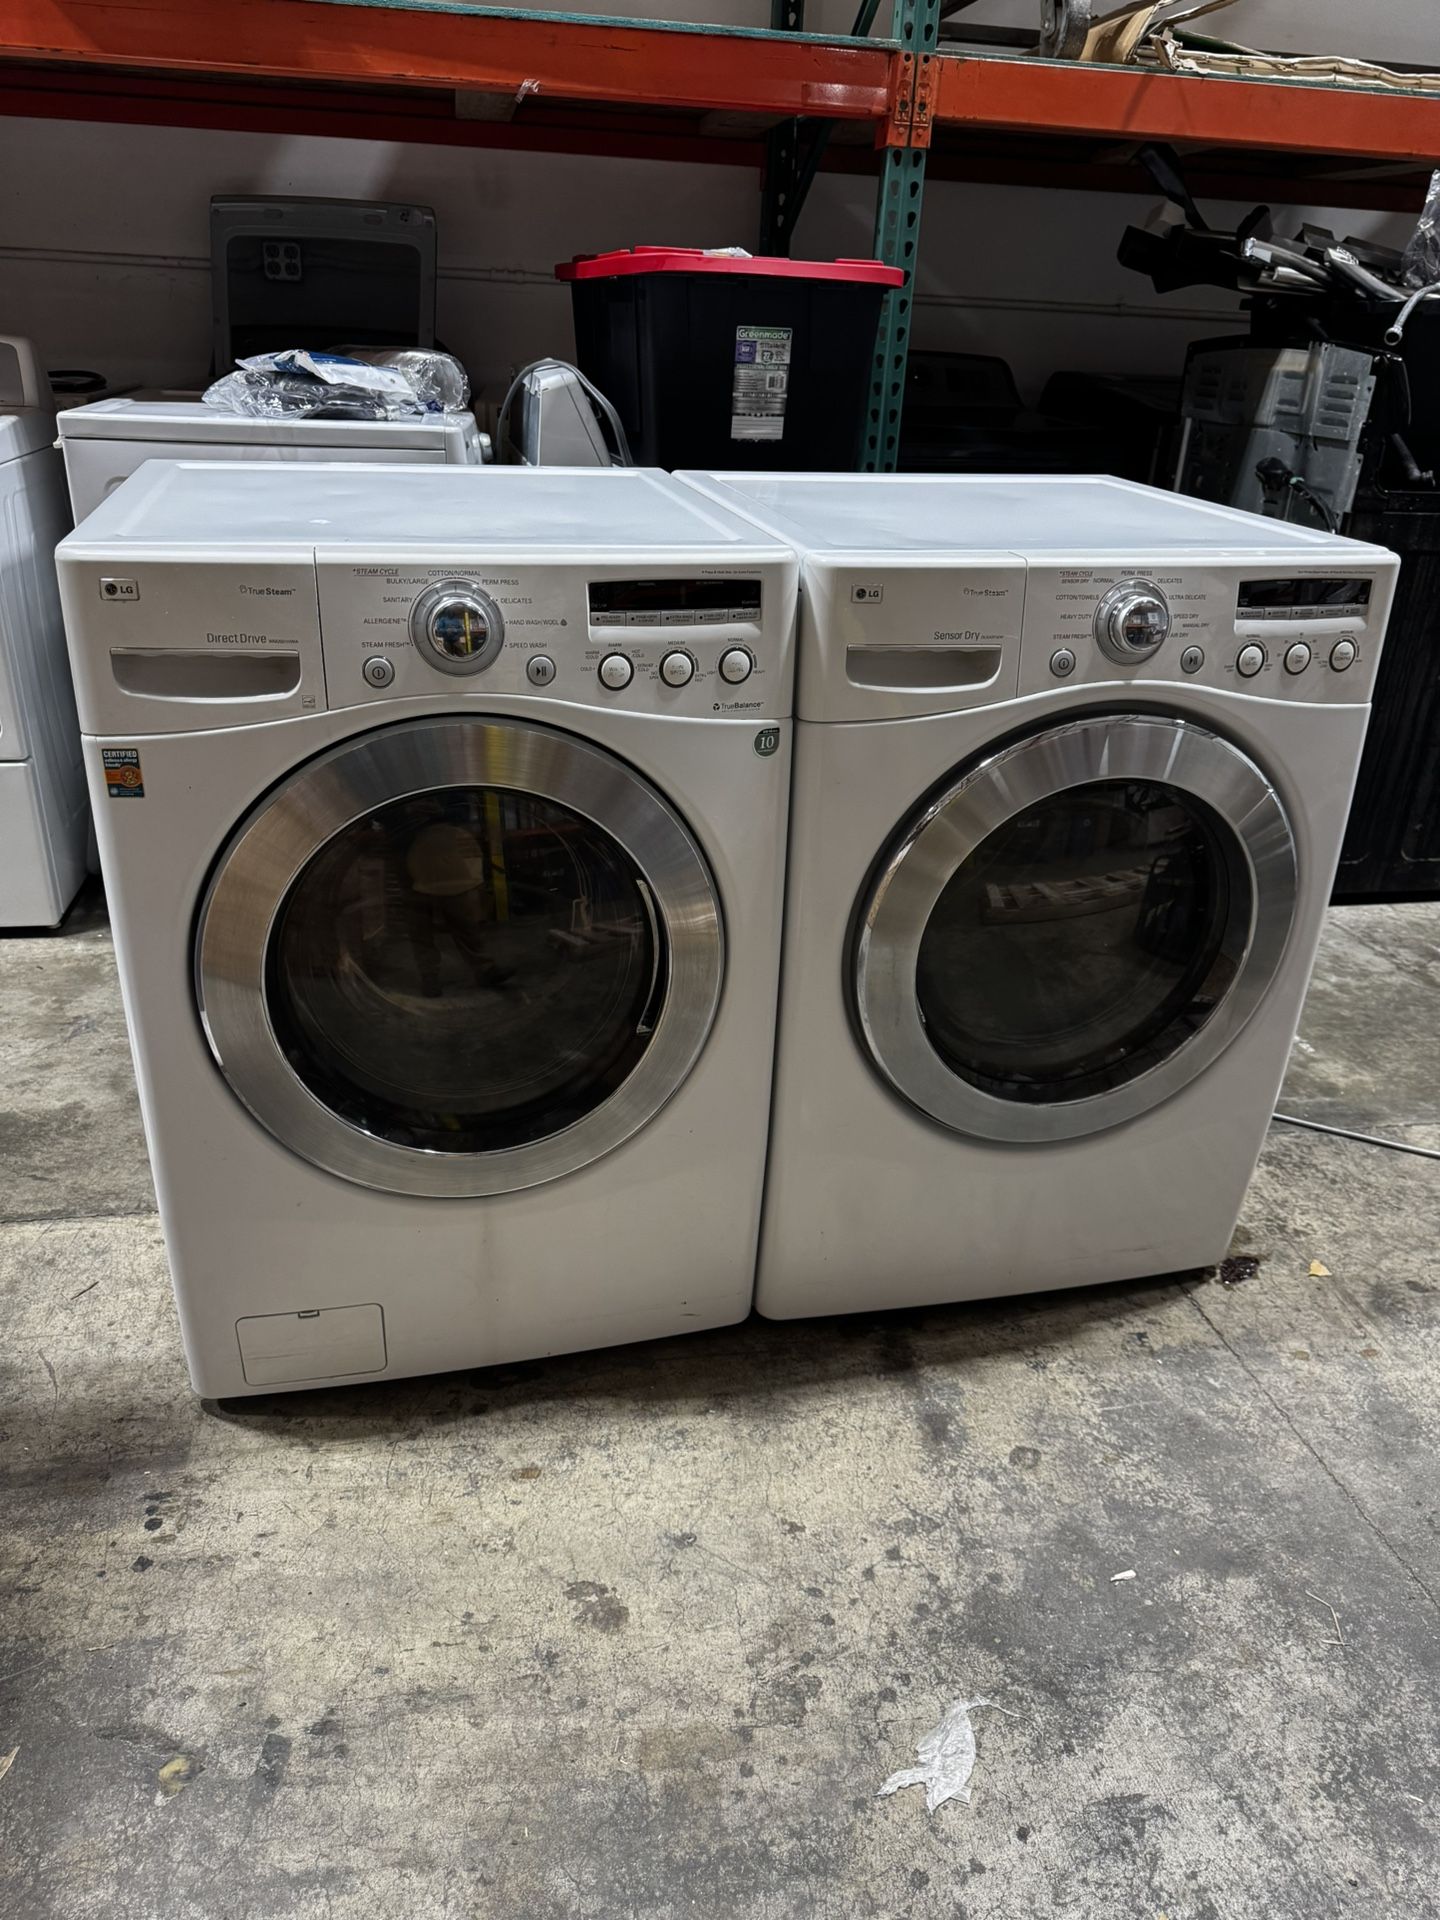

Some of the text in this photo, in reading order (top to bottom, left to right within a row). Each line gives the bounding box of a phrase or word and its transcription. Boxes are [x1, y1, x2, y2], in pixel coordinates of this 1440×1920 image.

[739, 328, 789, 340] Greenmade
[120, 586, 133, 595] LG
[868, 590, 879, 598] LG
[207, 632, 238, 644] Direct
[240, 633, 267, 644] Drive
[934, 631, 963, 640] Sensor
[965, 631, 981, 641] Dry
[761, 736, 774, 749] 10
